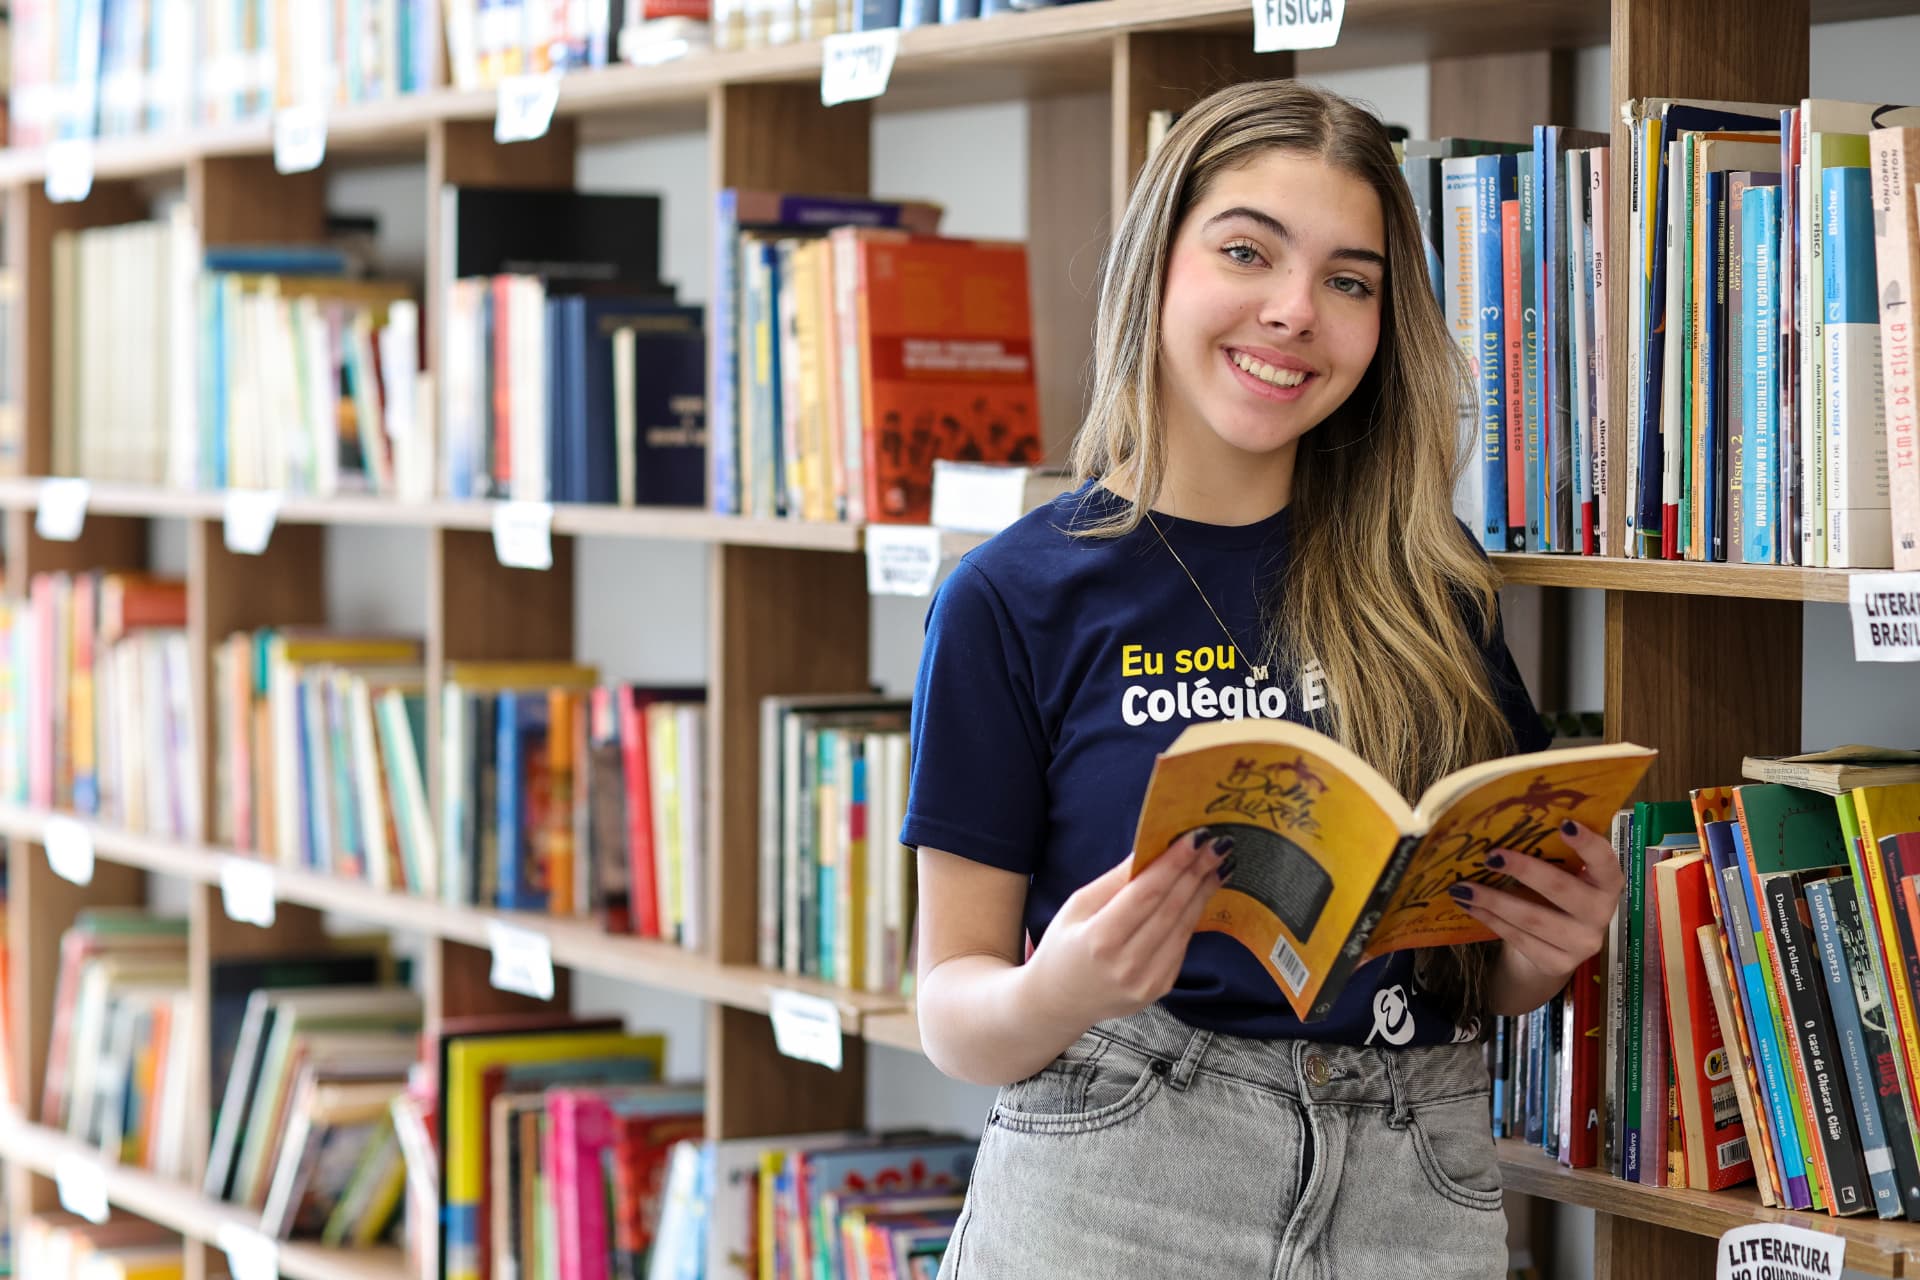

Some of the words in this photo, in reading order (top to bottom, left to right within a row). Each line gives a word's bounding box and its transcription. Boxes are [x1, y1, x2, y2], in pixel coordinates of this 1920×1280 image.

[1593, 171, 1600, 190] 3
[1882, 150, 1890, 212] BONJORNO
[1488, 176, 1496, 220] CLINTON
[1524, 174, 1532, 232] BONJORNO
[1828, 189, 1838, 236] Blucher
[1455, 206, 1473, 330] Fundamental
[1756, 244, 1769, 306] INTRODUÇÃO
[1481, 305, 1499, 321] 3
[1829, 302, 1841, 321] 2
[1512, 341, 1520, 349] O
[1757, 319, 1768, 353] TEORIA
[1815, 325, 1821, 337] 3
[1483, 331, 1498, 380] FÍSICA
[1756, 355, 1768, 369] DA
[1831, 331, 1840, 384] BÁSICA
[1890, 322, 1909, 377] FÍSICA
[1511, 353, 1522, 396] enigma
[1485, 387, 1499, 406] DE
[1756, 370, 1767, 437] ELETRICIDADE
[1895, 385, 1910, 406] DE
[1513, 398, 1524, 452] quântico
[1831, 389, 1841, 436] FÍSICA
[1485, 414, 1499, 463] TEMAS
[1731, 433, 1743, 445] 2
[1756, 446, 1767, 459] DO
[1833, 442, 1840, 459] DE
[1896, 415, 1912, 469] TEMAS
[1733, 494, 1740, 508] DE
[1755, 461, 1767, 528] MAGNETISMO
[1732, 509, 1740, 545] AULAS
[1122, 644, 1163, 677] Eu
[1174, 645, 1235, 674] sou
[1121, 676, 1287, 726] Colégio
[1723, 872, 1734, 882] 14
[1813, 893, 1829, 932] QUARTO
[1774, 892, 1791, 943] Domingos
[1787, 945, 1805, 992] Pellegrini
[1822, 931, 1830, 942] de
[1633, 970, 1639, 982] DE
[1823, 941, 1842, 983] DESPEJO
[1632, 1026, 1638, 1038] UM
[1803, 1019, 1814, 1029] O
[1905, 1031, 1913, 1044] de
[1632, 1040, 1637, 1050] DE
[1759, 1037, 1771, 1061] TERRA
[1806, 1033, 1821, 1057] caso
[1766, 1063, 1777, 1089] MINHA
[1812, 1057, 1825, 1072] da
[1846, 1030, 1859, 1070] CAROLINA
[1855, 1071, 1866, 1099] MARIA
[1861, 1101, 1869, 1112] DE
[1772, 1091, 1780, 1102] NA
[1815, 1072, 1835, 1113] Chácara
[1775, 1104, 1786, 1137] VIAGENS
[1825, 1114, 1843, 1141] Chão
[1627, 1131, 1636, 1171] Todolivro
[1729, 1237, 1831, 1276] LITERATURA
